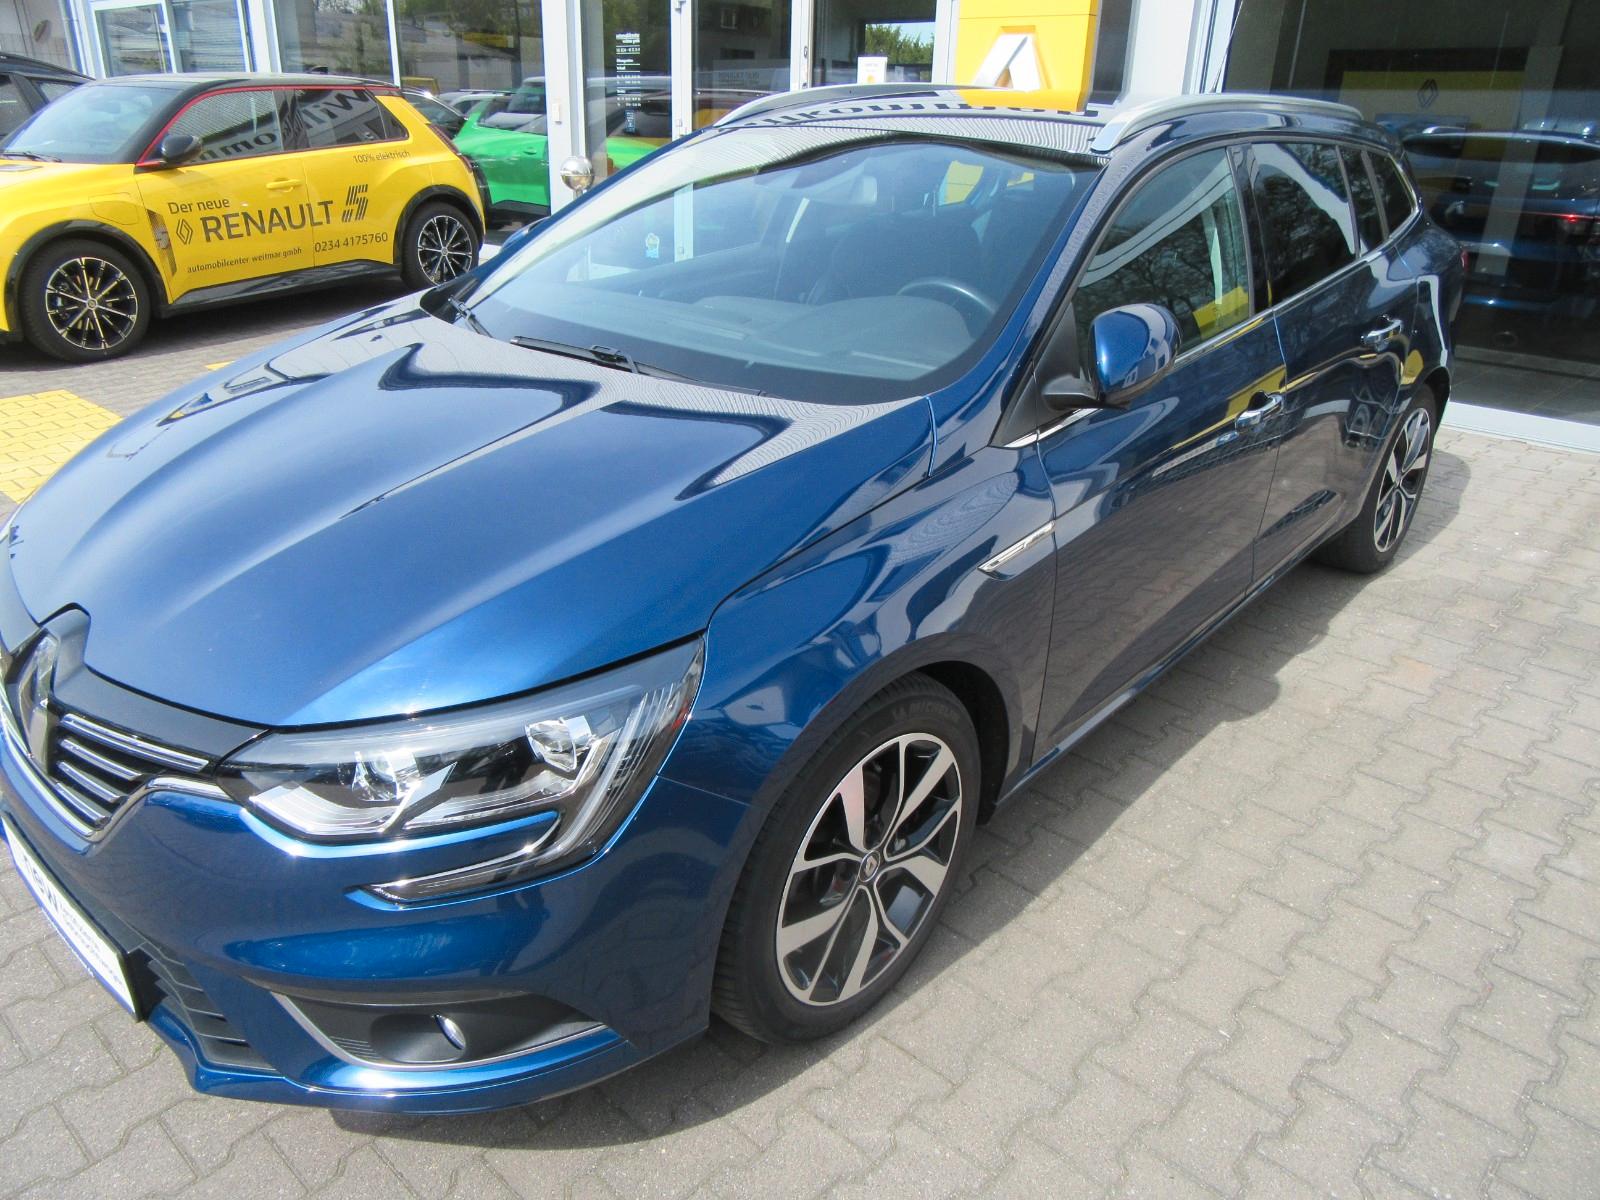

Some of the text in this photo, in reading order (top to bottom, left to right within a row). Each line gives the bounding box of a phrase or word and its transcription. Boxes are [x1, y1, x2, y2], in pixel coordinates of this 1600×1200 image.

[353, 150, 410, 164] 100% elektrisch
[167, 198, 230, 215] Der neue
[200, 200, 334, 242] RENAULT
[314, 232, 389, 253] 0234 4175760
[187, 247, 302, 273] automobilcenter weitmar gmbh
